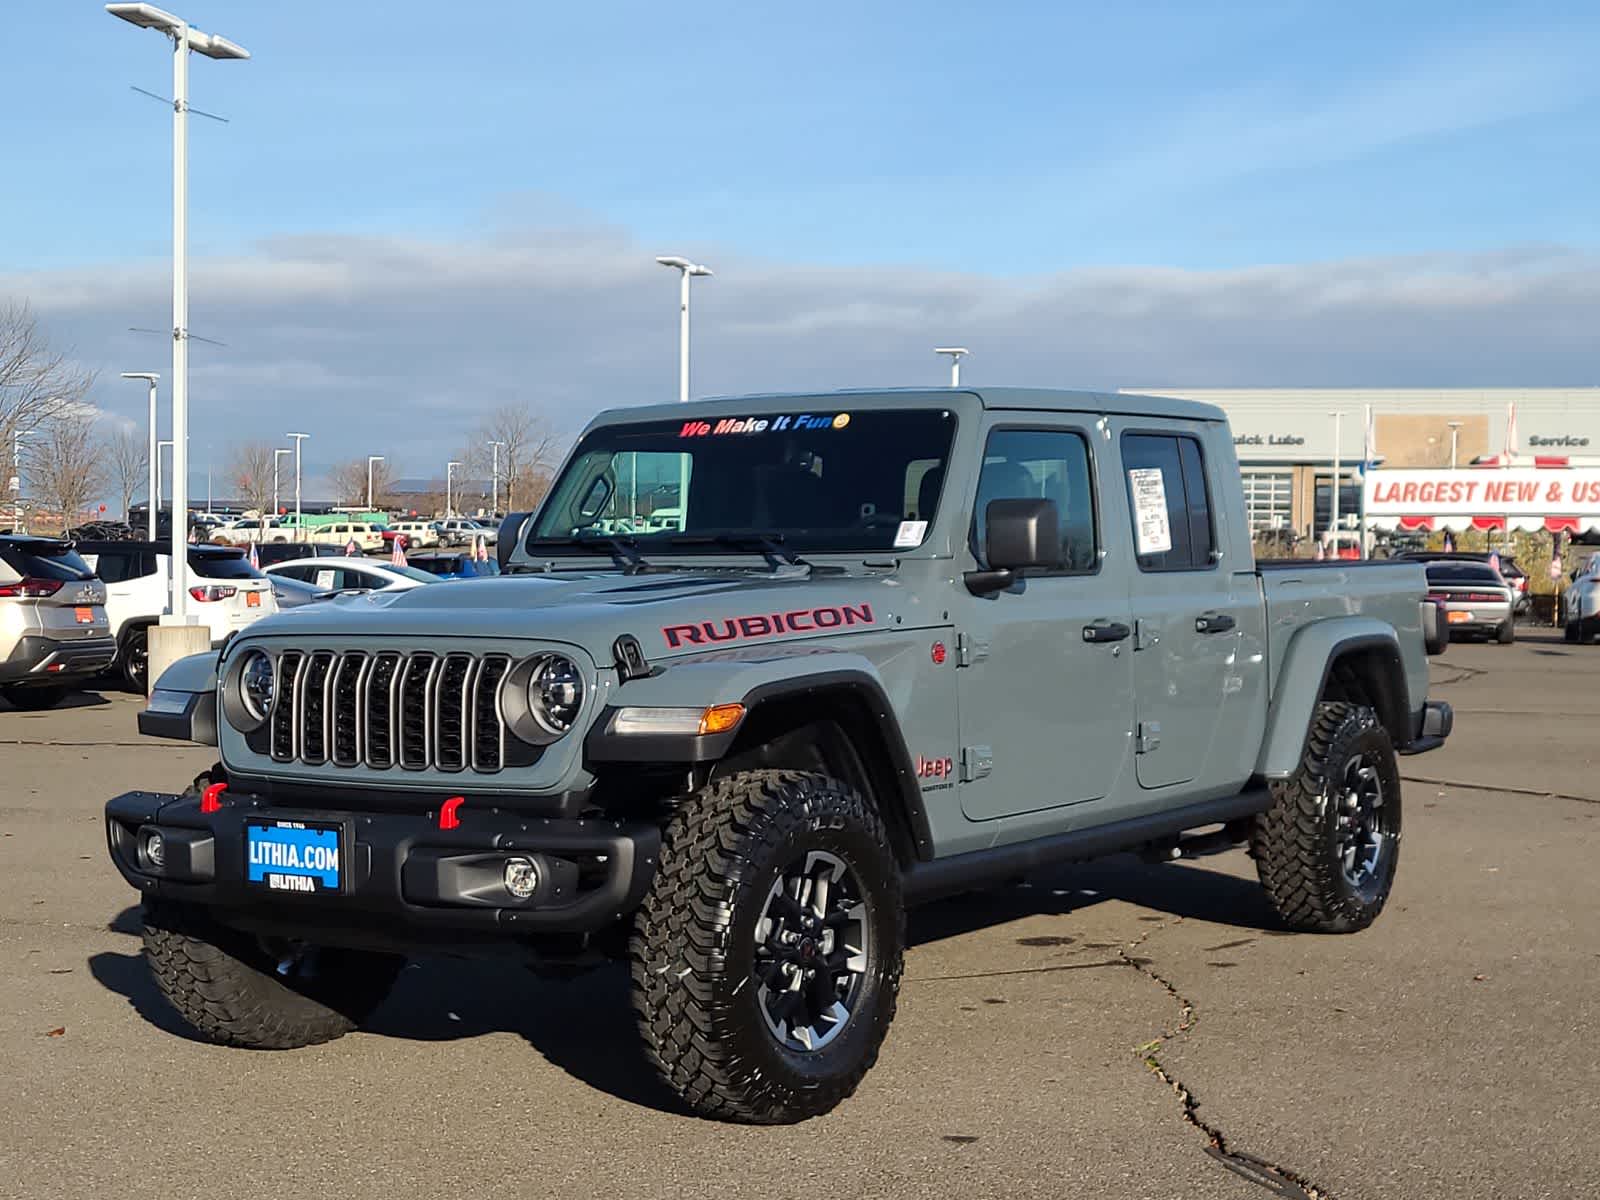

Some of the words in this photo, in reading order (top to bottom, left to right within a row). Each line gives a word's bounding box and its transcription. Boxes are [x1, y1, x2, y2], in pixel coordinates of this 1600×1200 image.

[679, 421, 711, 438] We
[713, 417, 769, 435] Make
[771, 415, 791, 431] It
[793, 414, 833, 430] Fun
[1268, 433, 1304, 446] Lube
[1528, 434, 1590, 447] Service
[1373, 481, 1479, 503] LARGEST
[1484, 481, 1540, 503] NEW
[1546, 480, 1564, 503] &
[663, 602, 874, 649] RUBICON
[916, 754, 953, 780] Jeep
[250, 840, 339, 872] LITHIA.COM
[280, 874, 315, 892] LITHIA
